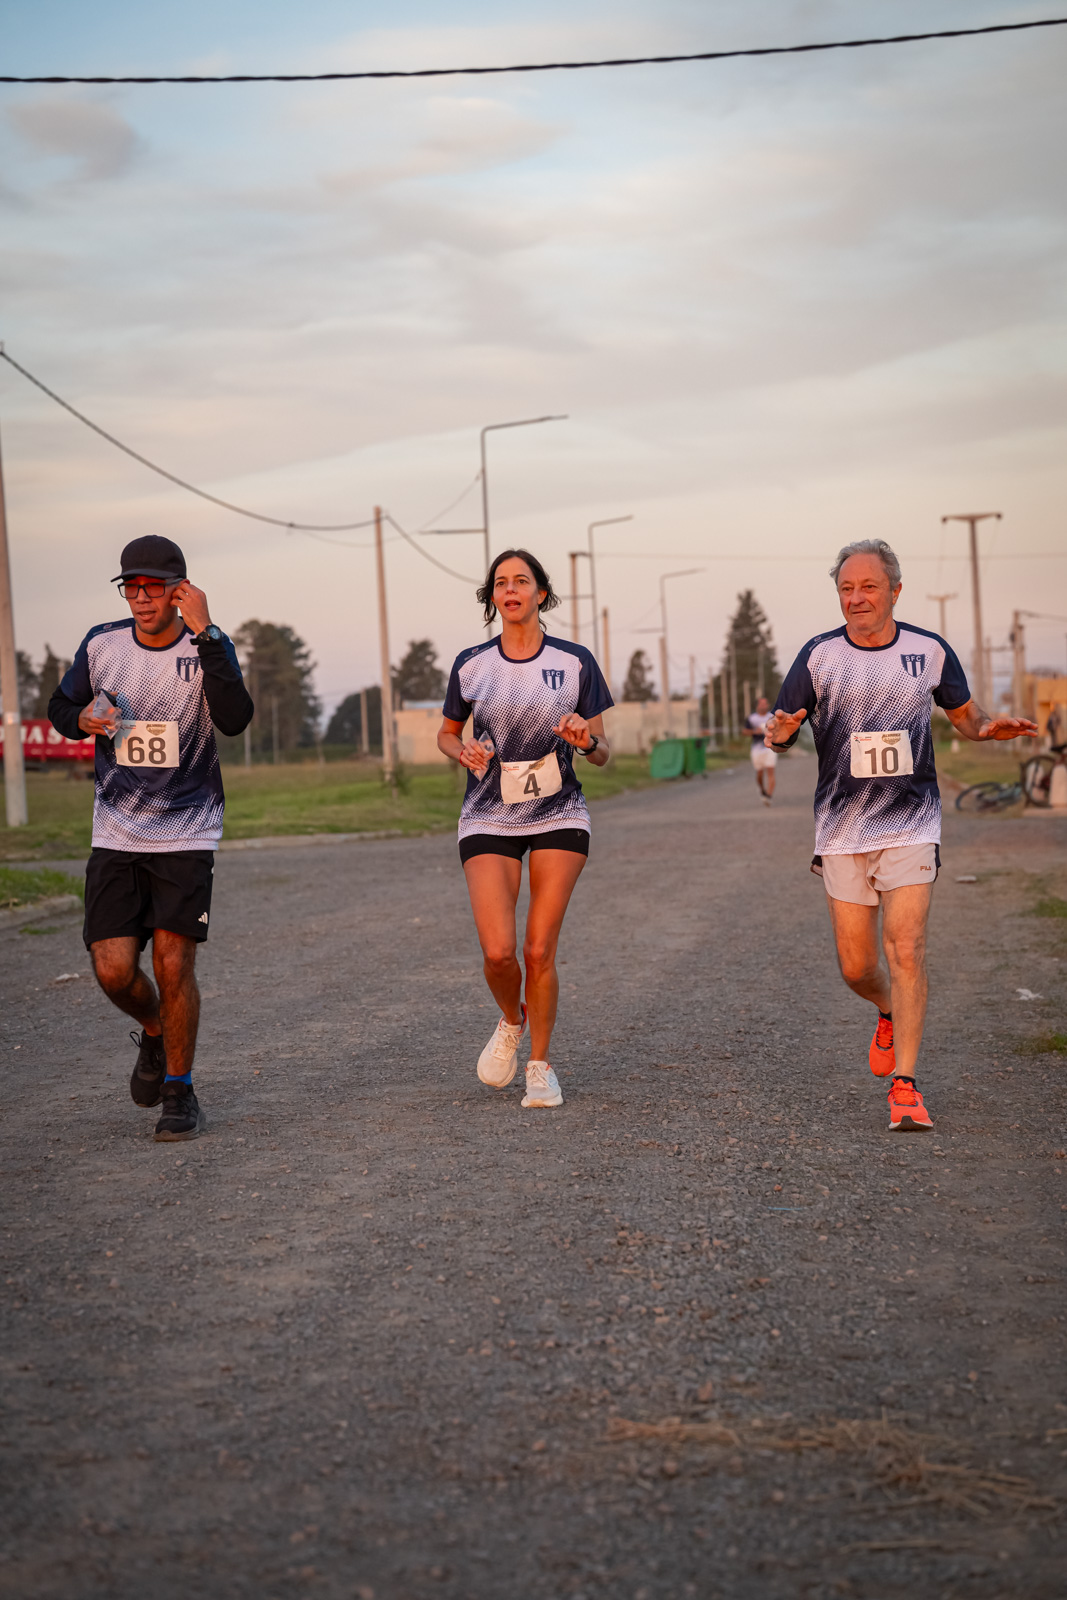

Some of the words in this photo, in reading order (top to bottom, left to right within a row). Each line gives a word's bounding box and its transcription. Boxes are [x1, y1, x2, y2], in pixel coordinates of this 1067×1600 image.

[127, 736, 167, 765] 68
[864, 746, 899, 775] 10
[523, 772, 542, 797] 4
